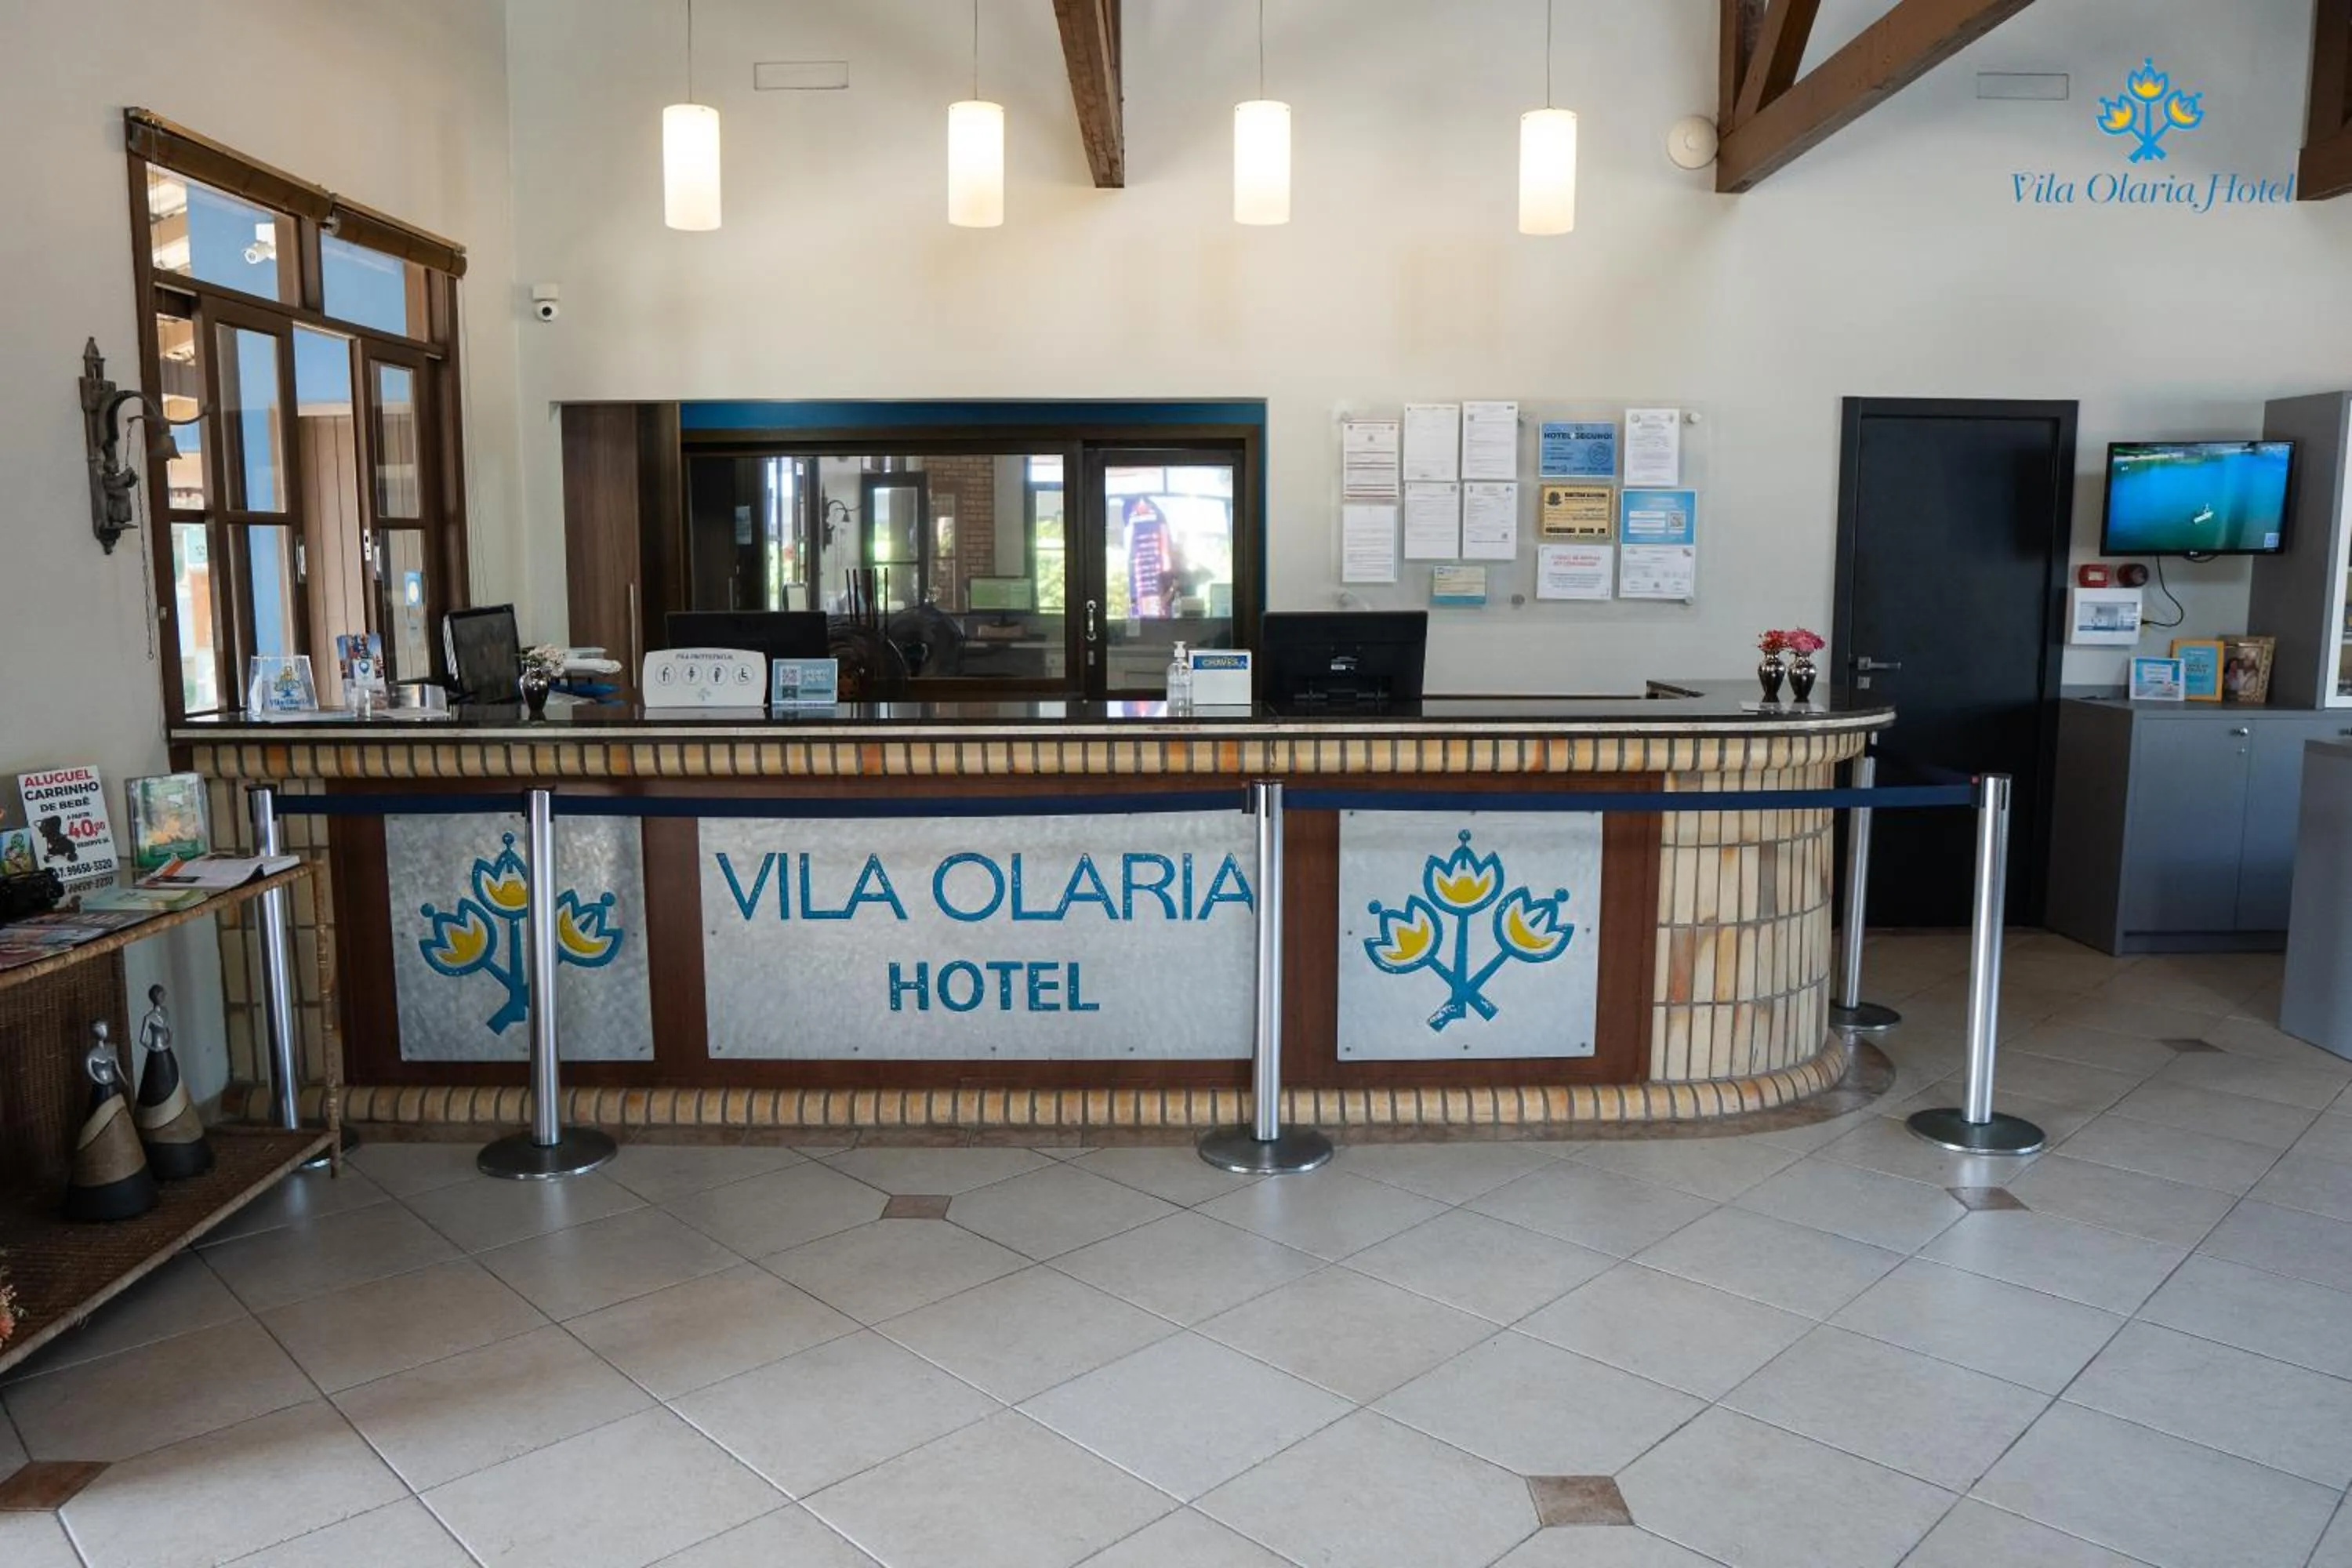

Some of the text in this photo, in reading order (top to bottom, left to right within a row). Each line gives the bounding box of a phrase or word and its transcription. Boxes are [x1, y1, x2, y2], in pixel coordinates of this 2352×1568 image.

[24, 769, 93, 787] ALUGUEL
[24, 781, 100, 800] CARRINHO
[40, 797, 91, 812] DE BEBÊ
[716, 851, 1254, 922] VILA OLARIA
[888, 959, 1100, 1012] HOTEL
